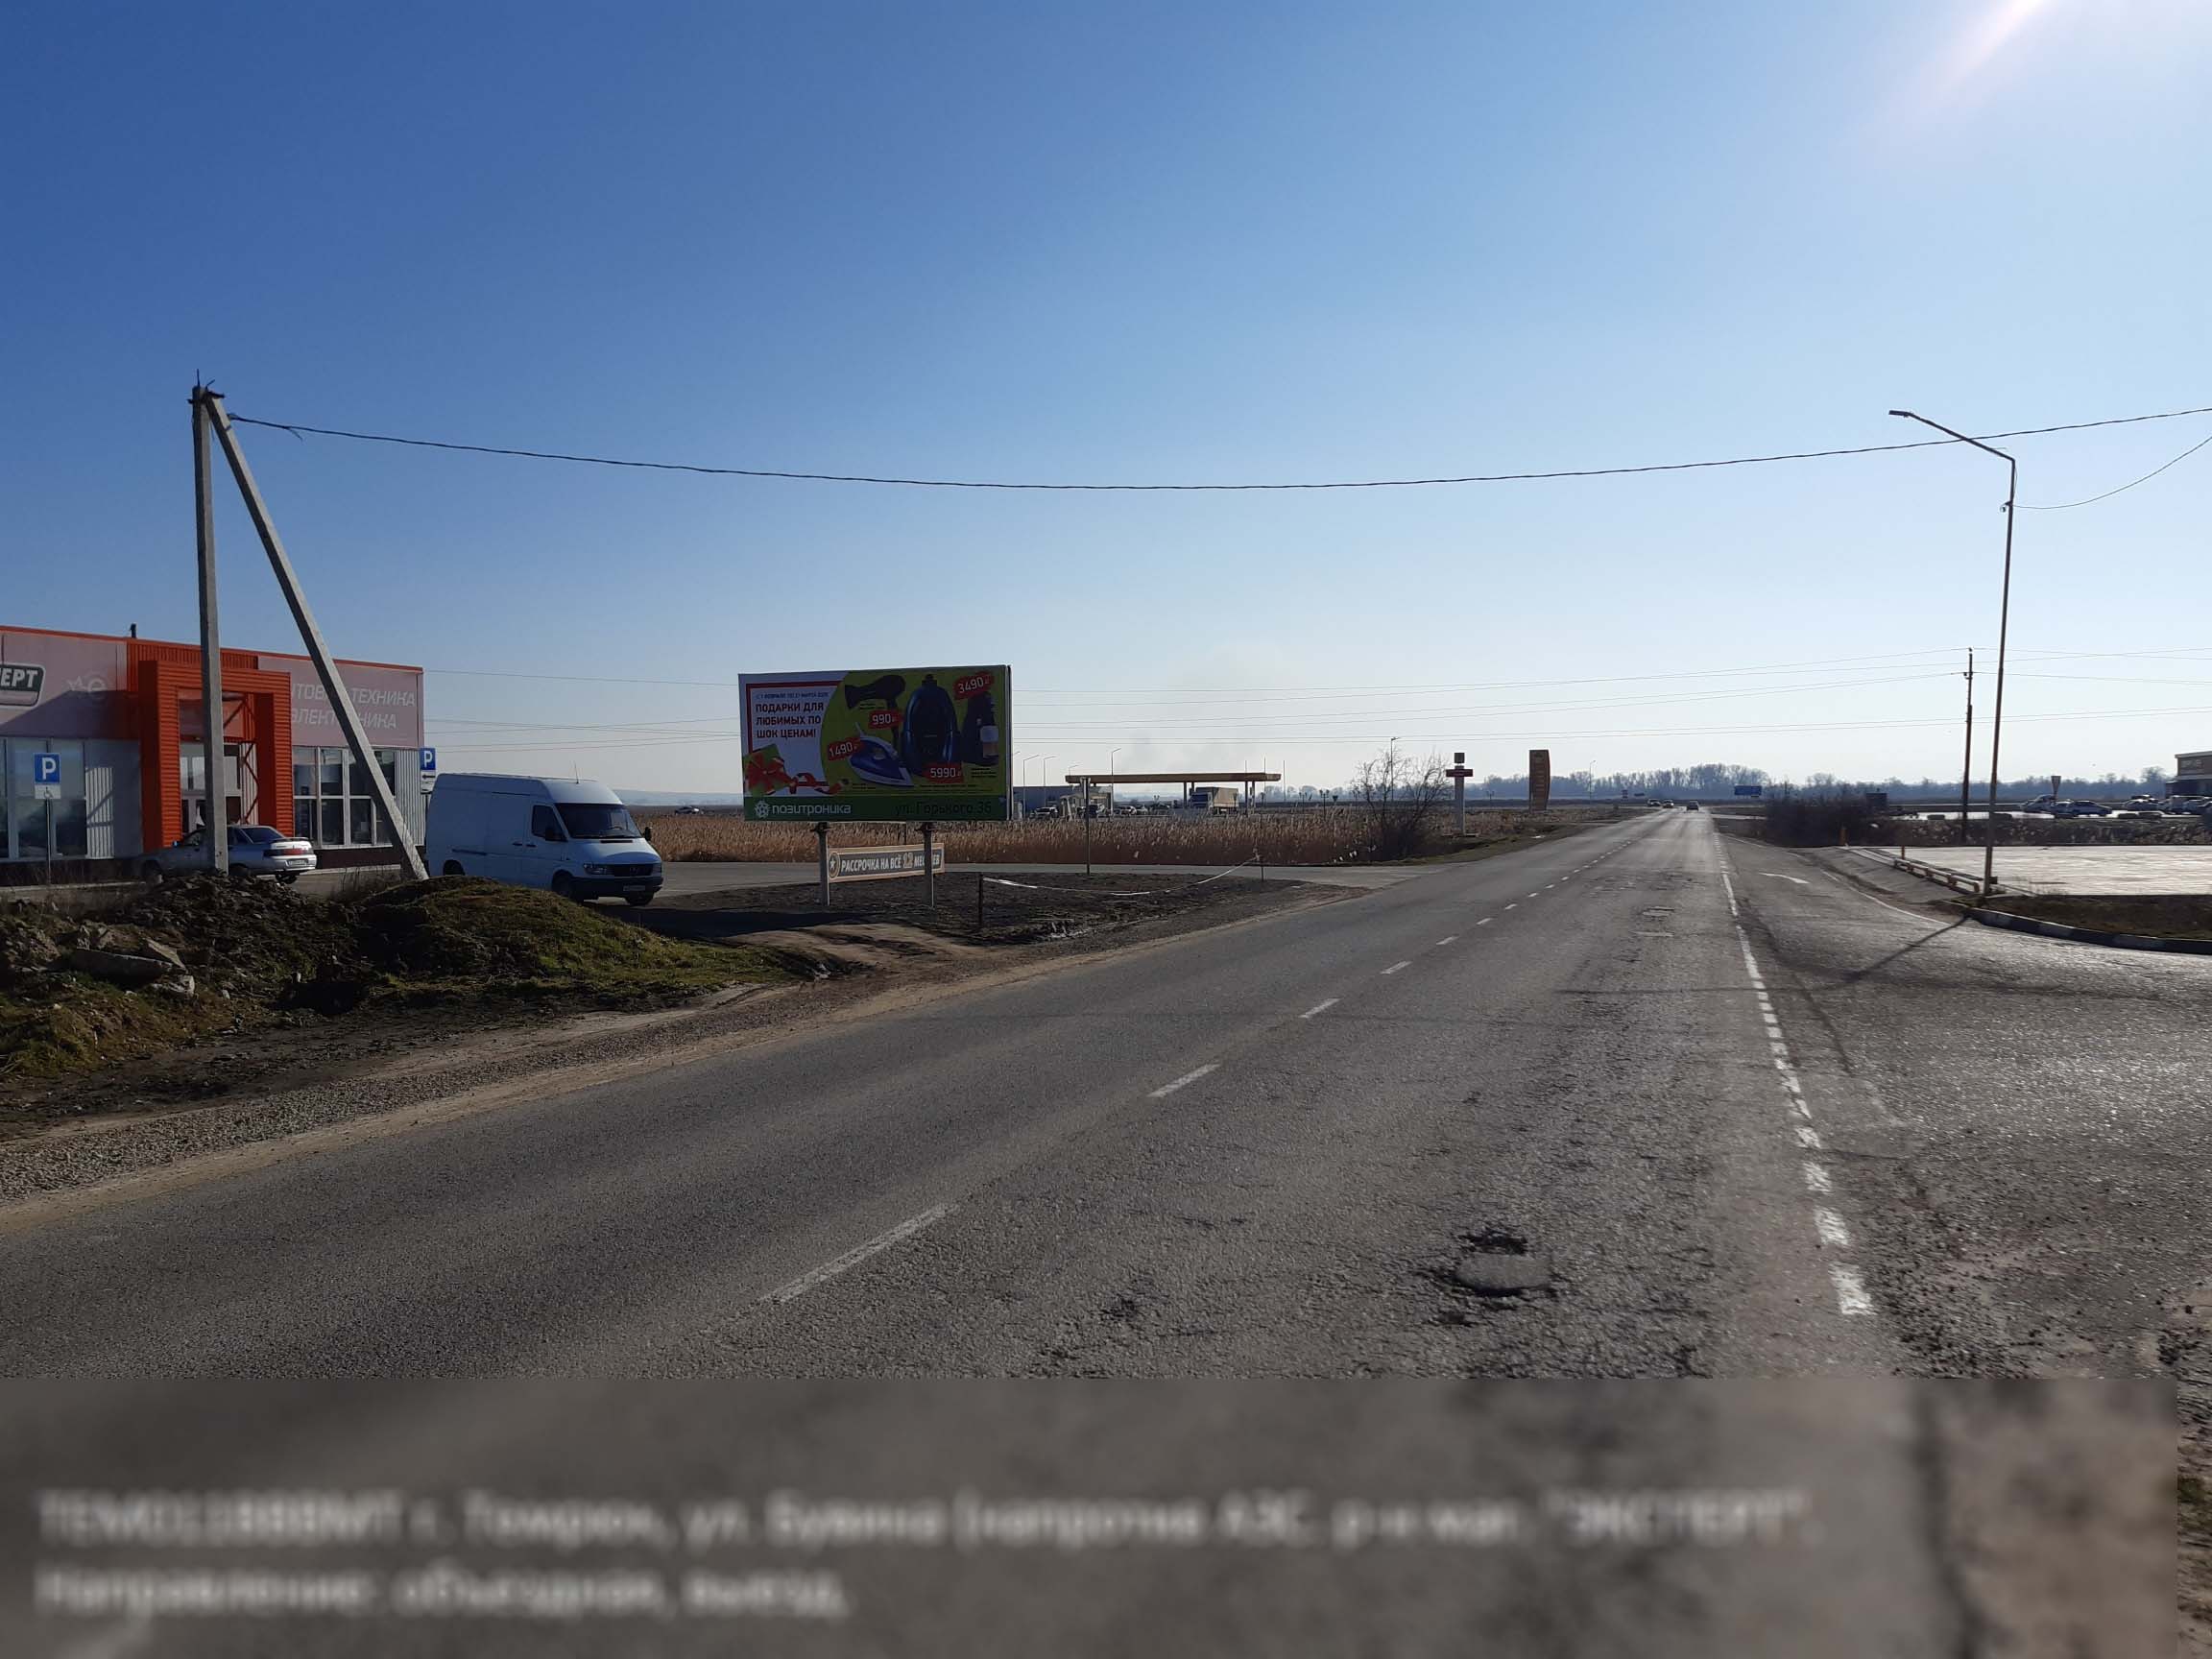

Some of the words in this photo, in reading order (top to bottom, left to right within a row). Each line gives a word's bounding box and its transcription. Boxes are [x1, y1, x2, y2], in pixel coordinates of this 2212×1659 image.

[0, 667, 38, 688] ЕРТ
[957, 676, 984, 693] 3490
[350, 687, 416, 707] ТЕХНИКА
[756, 702, 801, 714] ПОДАРКИ
[804, 702, 824, 713] ДЛЯ
[756, 715, 805, 726] ЛЮБИМЫХ
[807, 714, 821, 724] ПО
[872, 713, 892, 725] 990
[757, 729, 779, 738] ШОК
[781, 728, 816, 741] ЦЕНАМ!
[830, 741, 854, 757] 1490
[423, 750, 433, 769] P
[42, 757, 57, 781] P
[930, 767, 956, 779] 5990
[841, 858, 879, 873] РАССРОЧКА
[880, 857, 890, 870] НА
